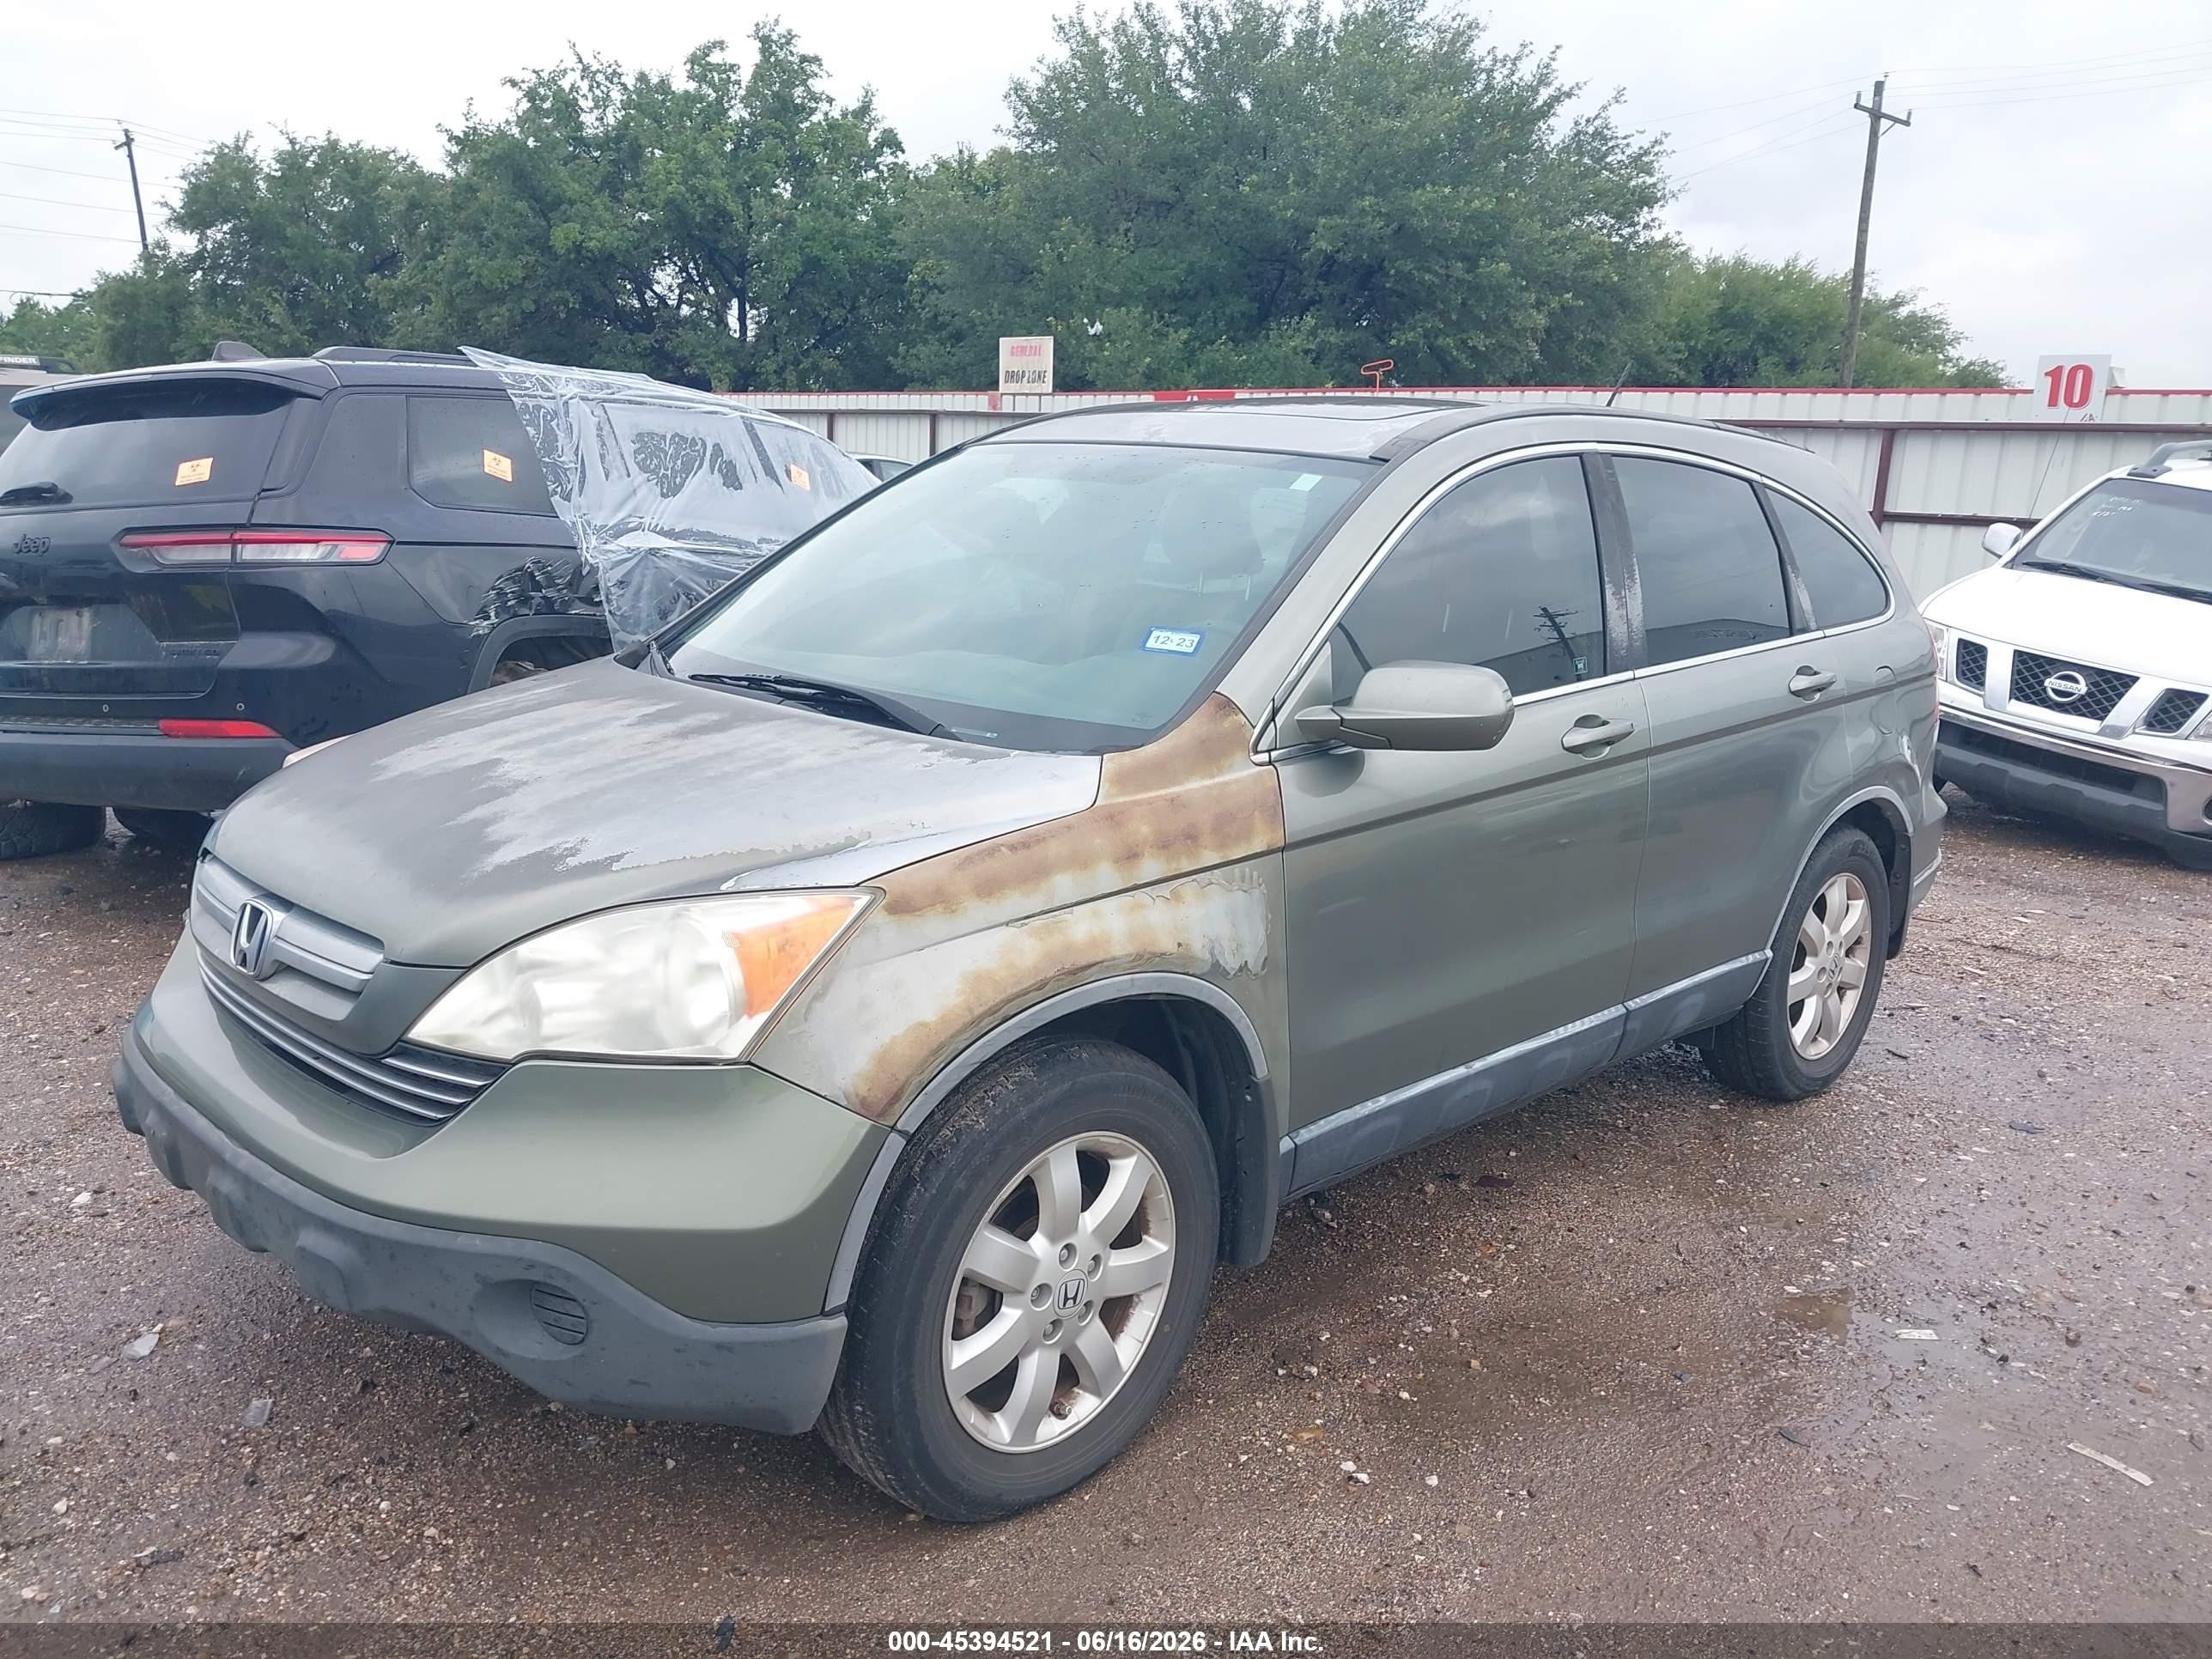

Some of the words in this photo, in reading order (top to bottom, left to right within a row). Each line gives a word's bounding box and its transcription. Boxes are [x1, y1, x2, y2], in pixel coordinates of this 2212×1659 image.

[1005, 370, 1025, 384] DROP
[2044, 363, 2094, 410] 10
[13, 533, 51, 557] Jeep
[1153, 635, 1170, 645] 12
[1176, 637, 1195, 648] 23
[2048, 680, 2082, 693] NISSAN
